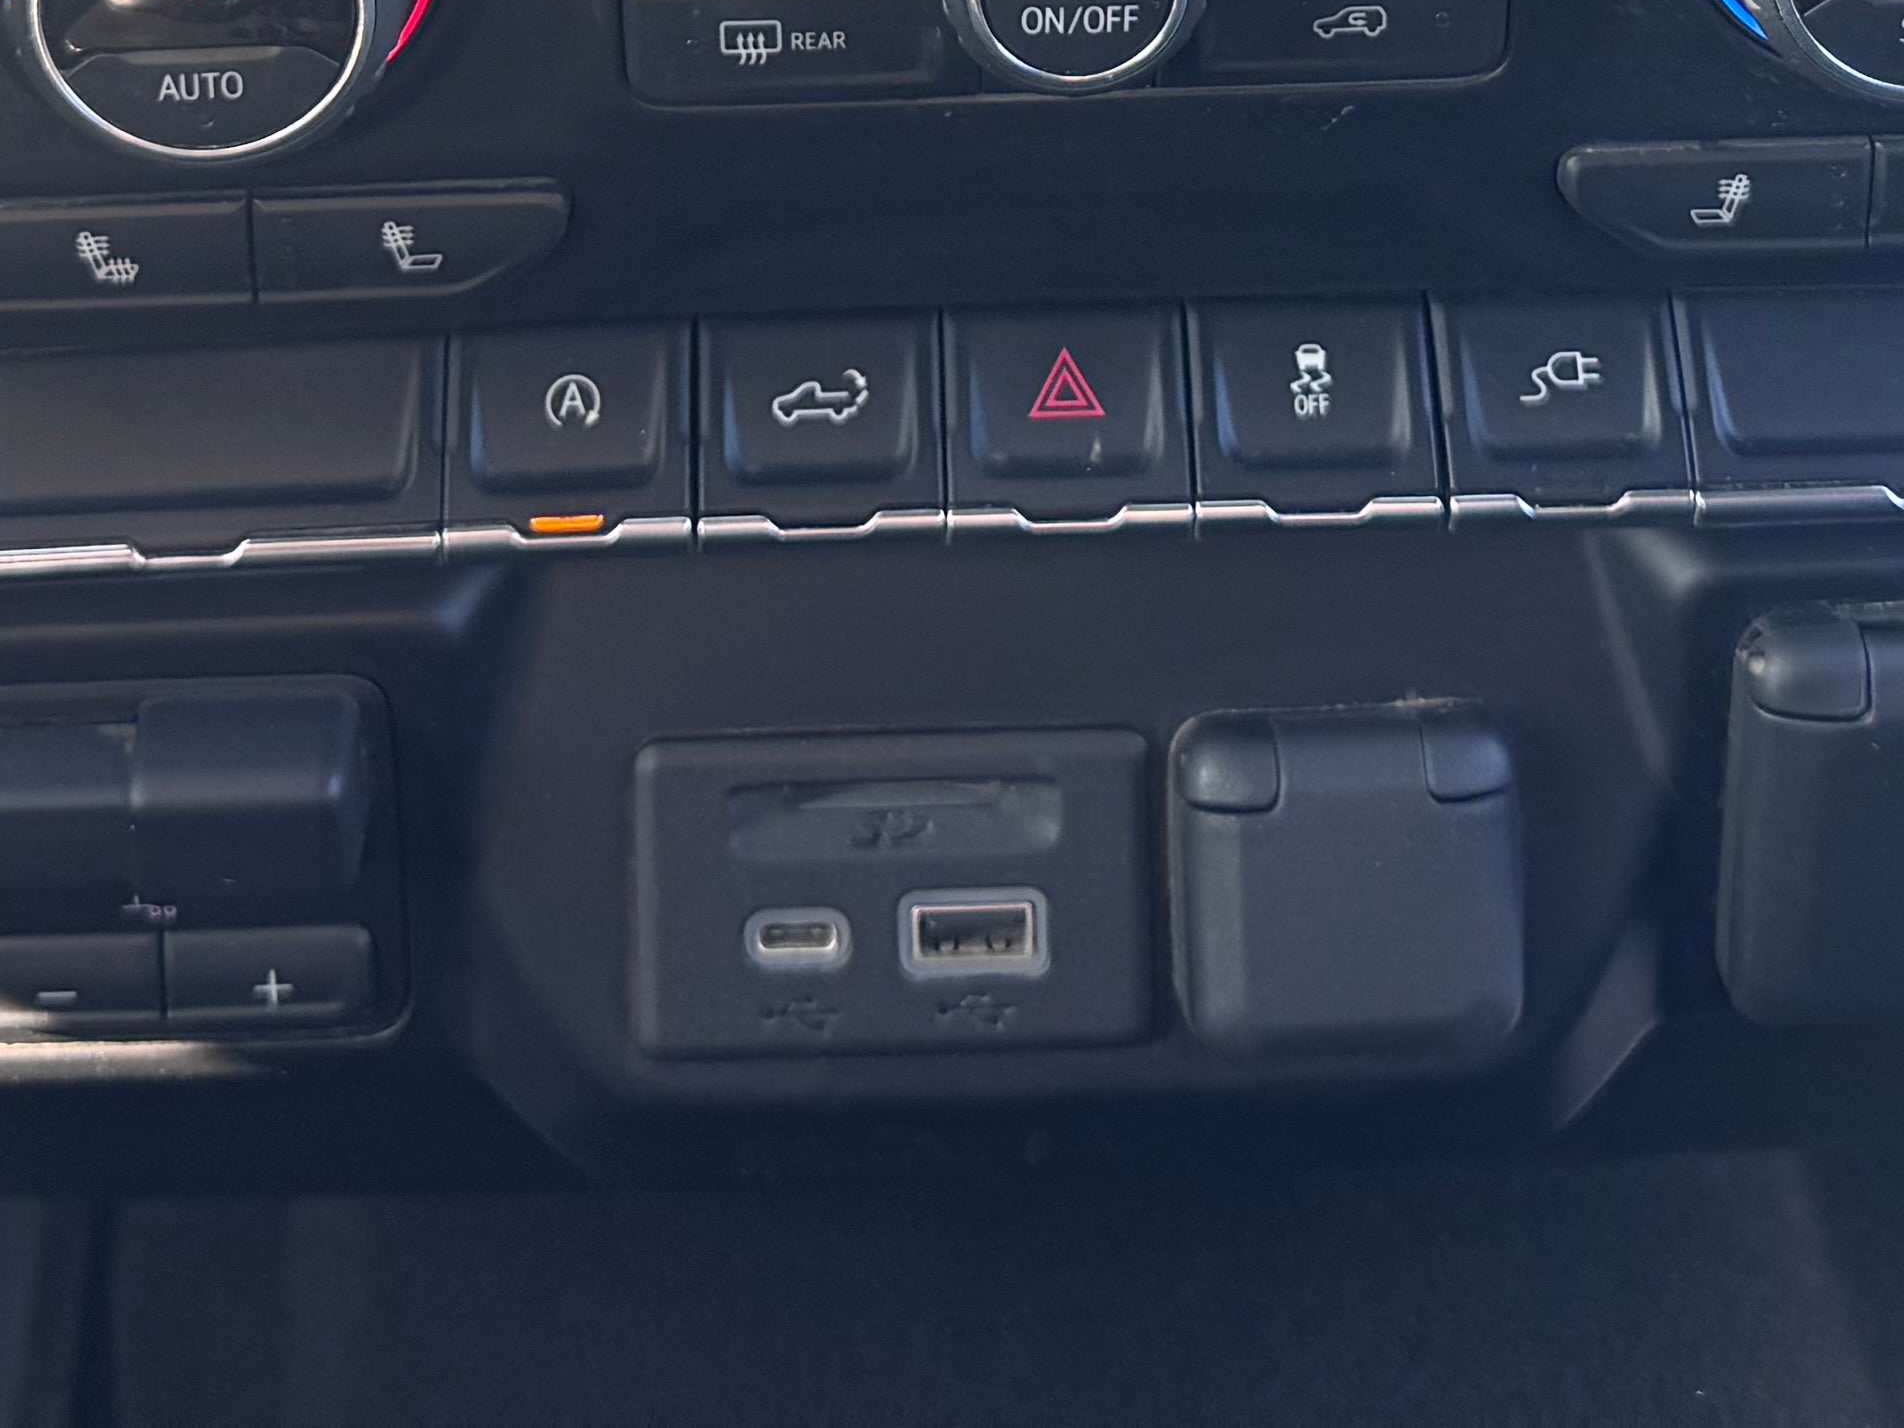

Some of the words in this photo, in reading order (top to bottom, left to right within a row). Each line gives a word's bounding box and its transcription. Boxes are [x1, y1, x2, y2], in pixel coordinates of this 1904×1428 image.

[1020, 5, 1140, 37] ON/OFF
[790, 30, 847, 50] REAR
[157, 70, 245, 101] AUTO
[1294, 393, 1331, 418] OFF
